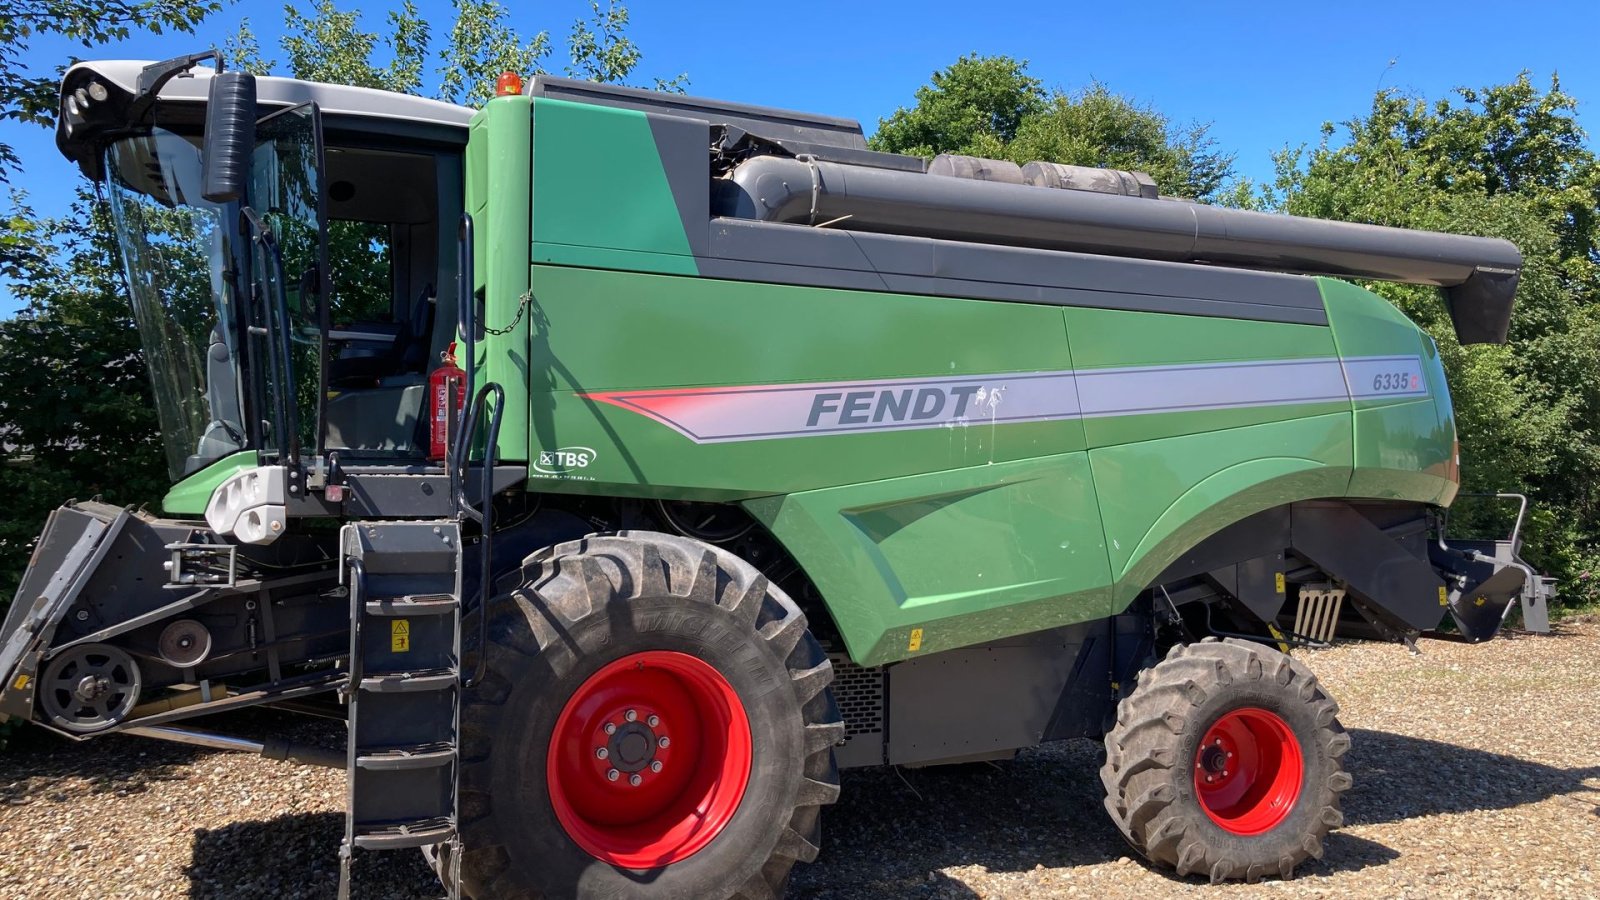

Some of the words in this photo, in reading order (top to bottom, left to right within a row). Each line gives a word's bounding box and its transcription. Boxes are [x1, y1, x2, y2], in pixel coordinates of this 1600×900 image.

[806, 385, 984, 427] FENDT
[555, 452, 588, 468] TBS
[638, 609, 778, 690] MICHELIN
